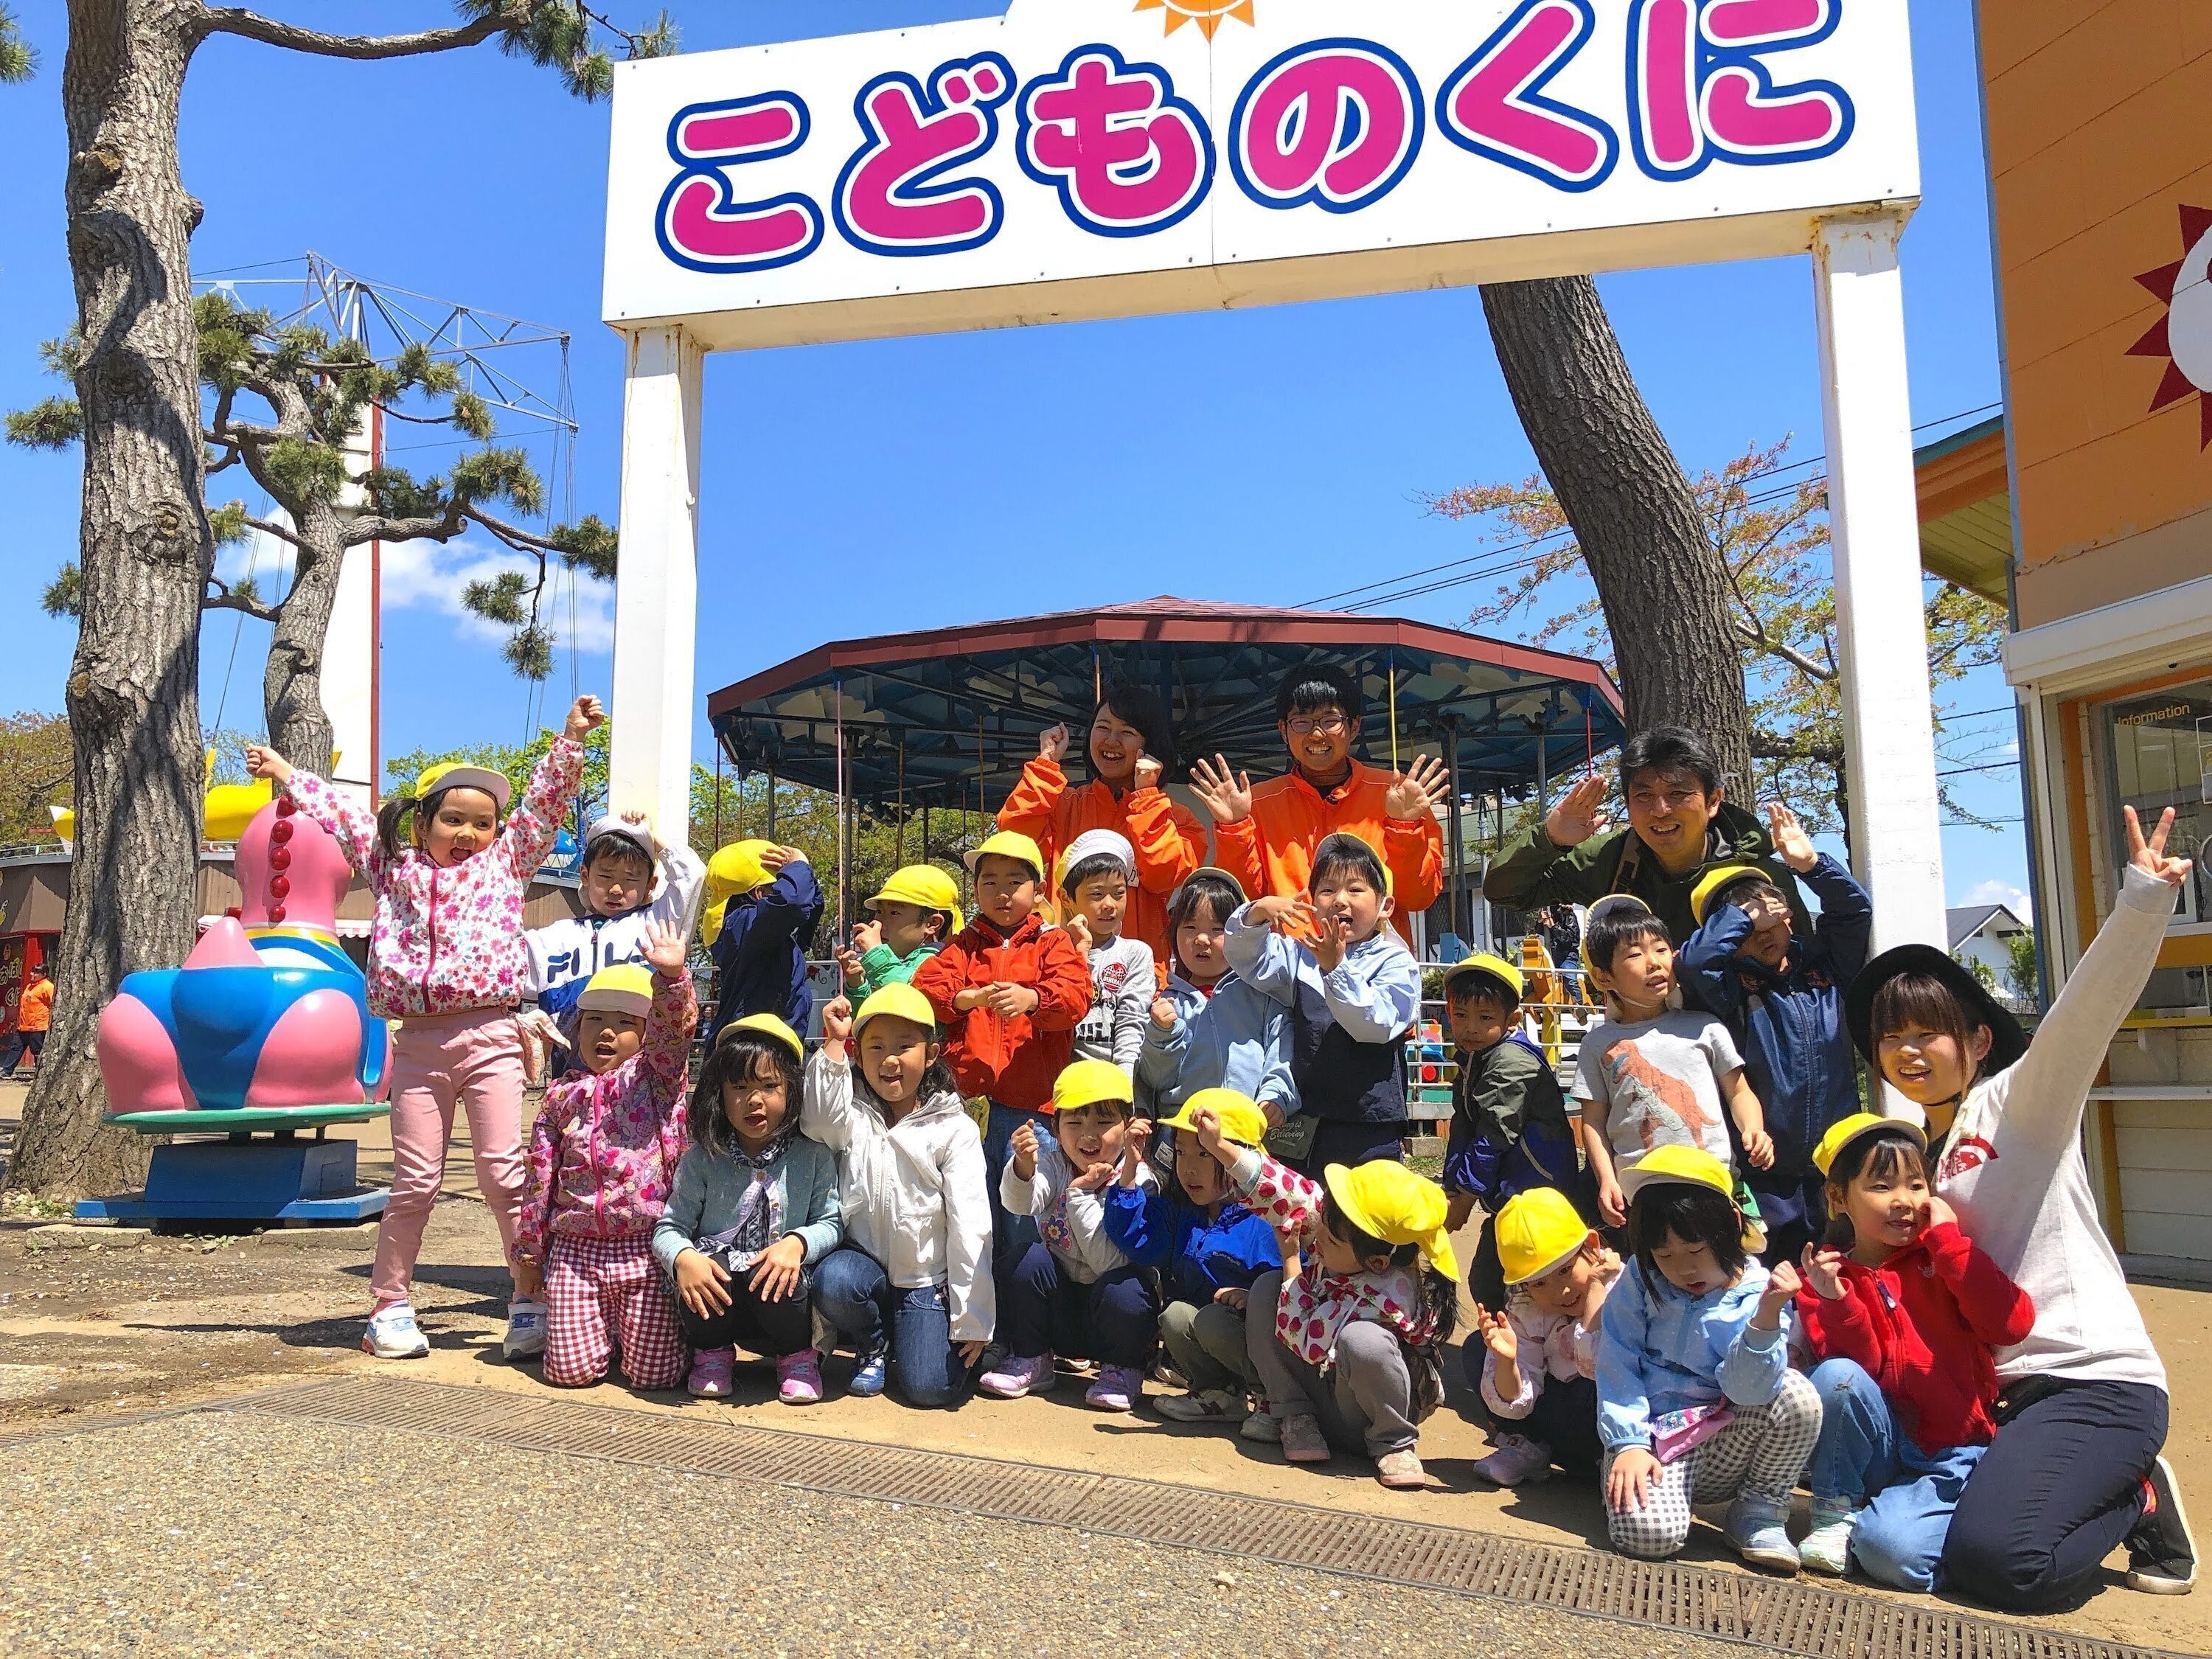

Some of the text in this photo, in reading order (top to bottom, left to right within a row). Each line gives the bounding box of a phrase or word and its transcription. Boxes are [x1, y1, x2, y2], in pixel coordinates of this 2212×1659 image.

[655, 0, 1855, 273] こどものくに
[2118, 704, 2190, 726] Information
[547, 937, 647, 984] FILA
